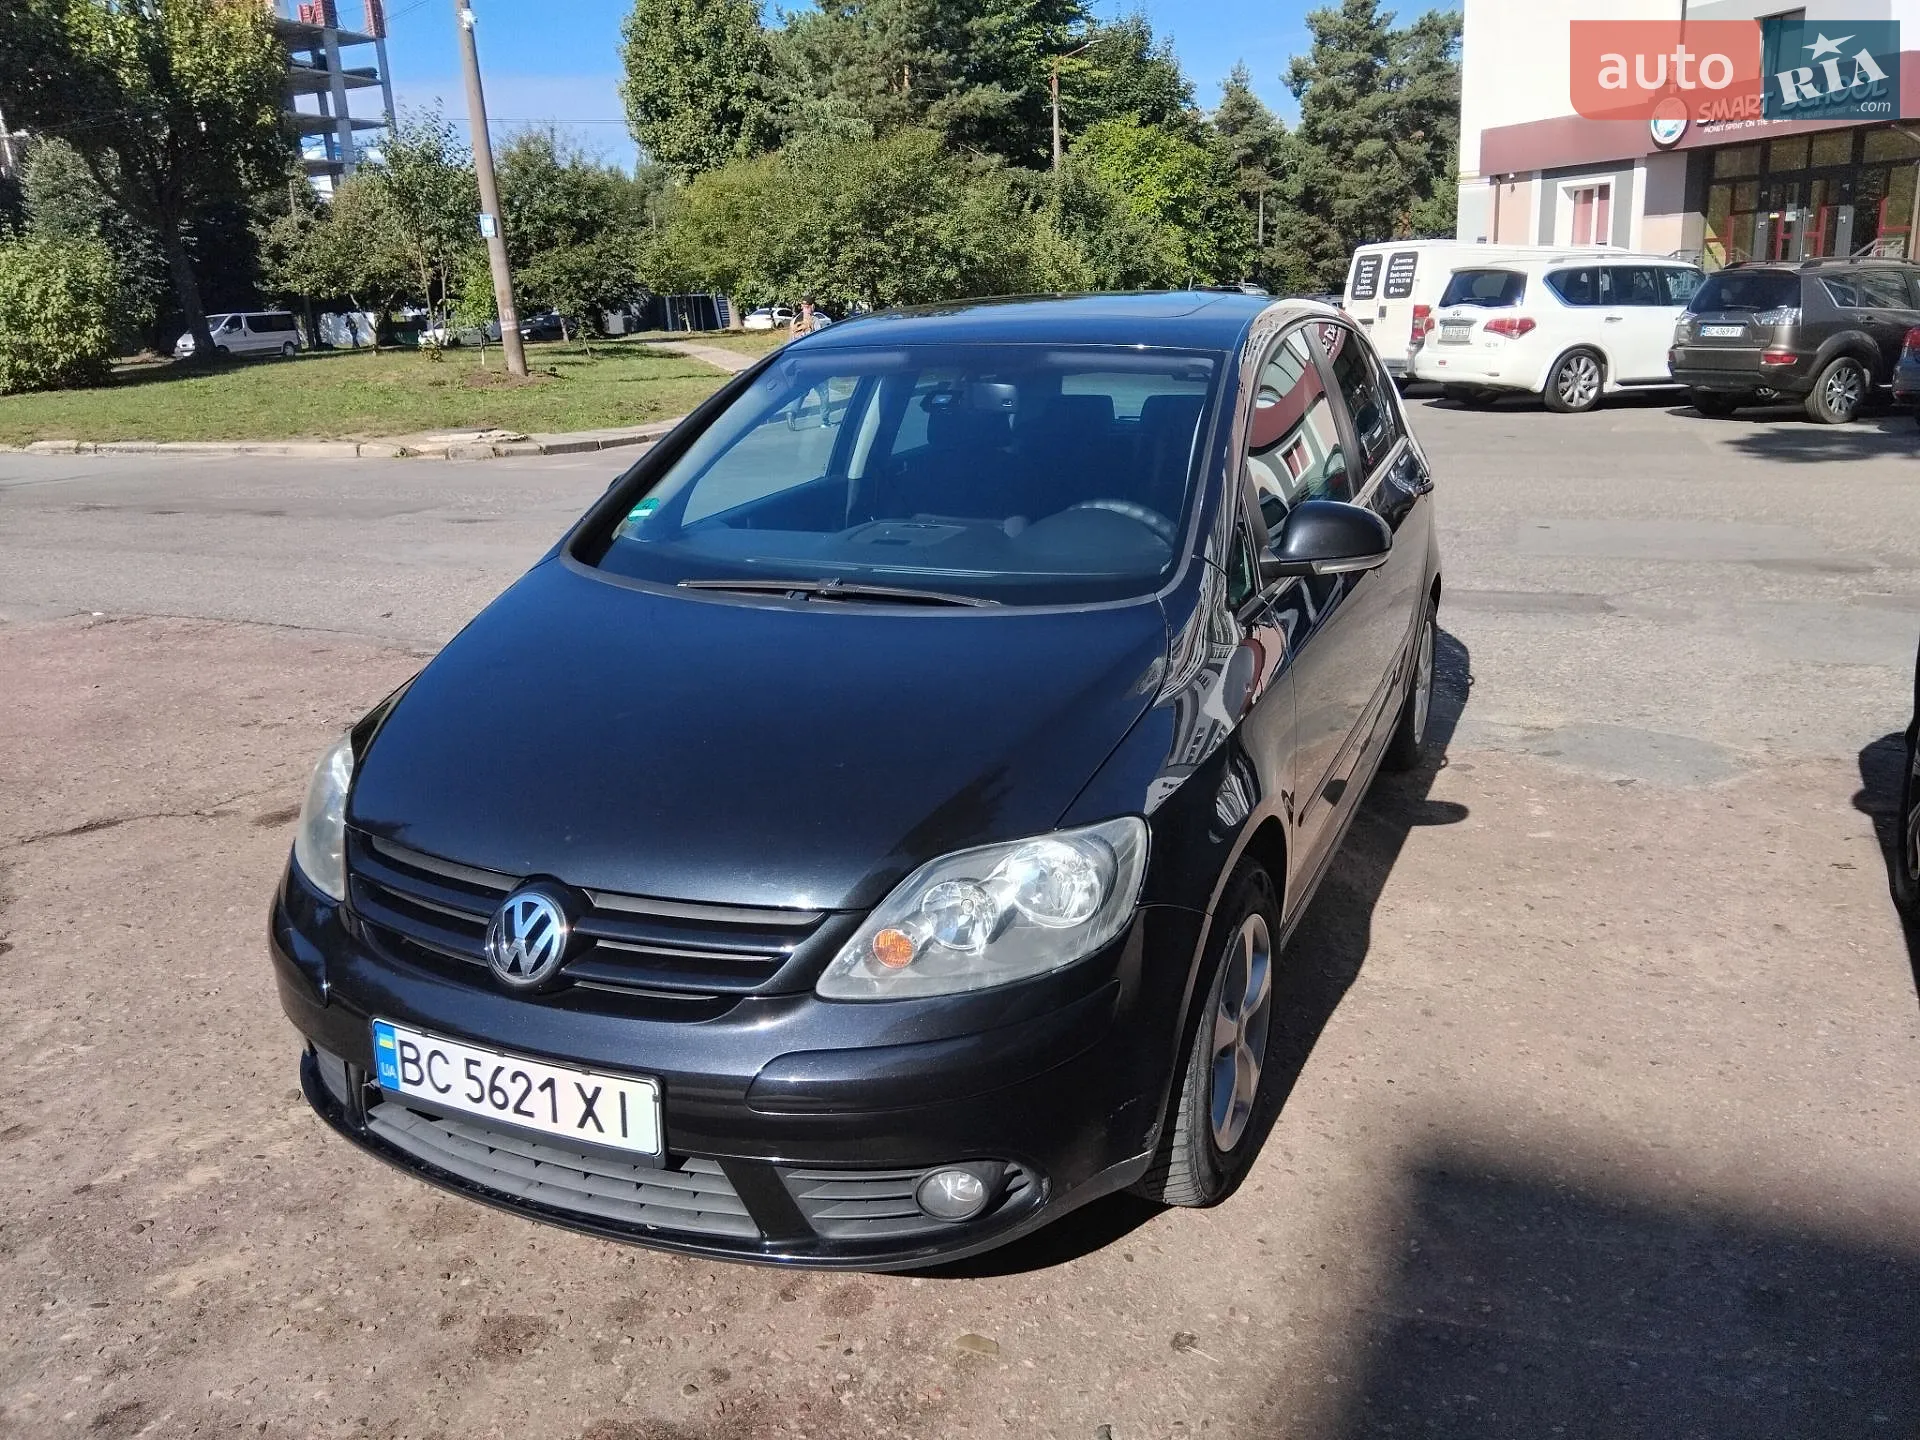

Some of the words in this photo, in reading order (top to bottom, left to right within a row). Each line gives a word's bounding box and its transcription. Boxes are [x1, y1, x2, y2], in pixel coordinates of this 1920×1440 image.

[1696, 90, 1775, 124] SMART
[380, 1062, 398, 1079] UA
[399, 1039, 451, 1094] BC
[464, 1058, 558, 1123] 5621
[575, 1082, 628, 1138] XI
